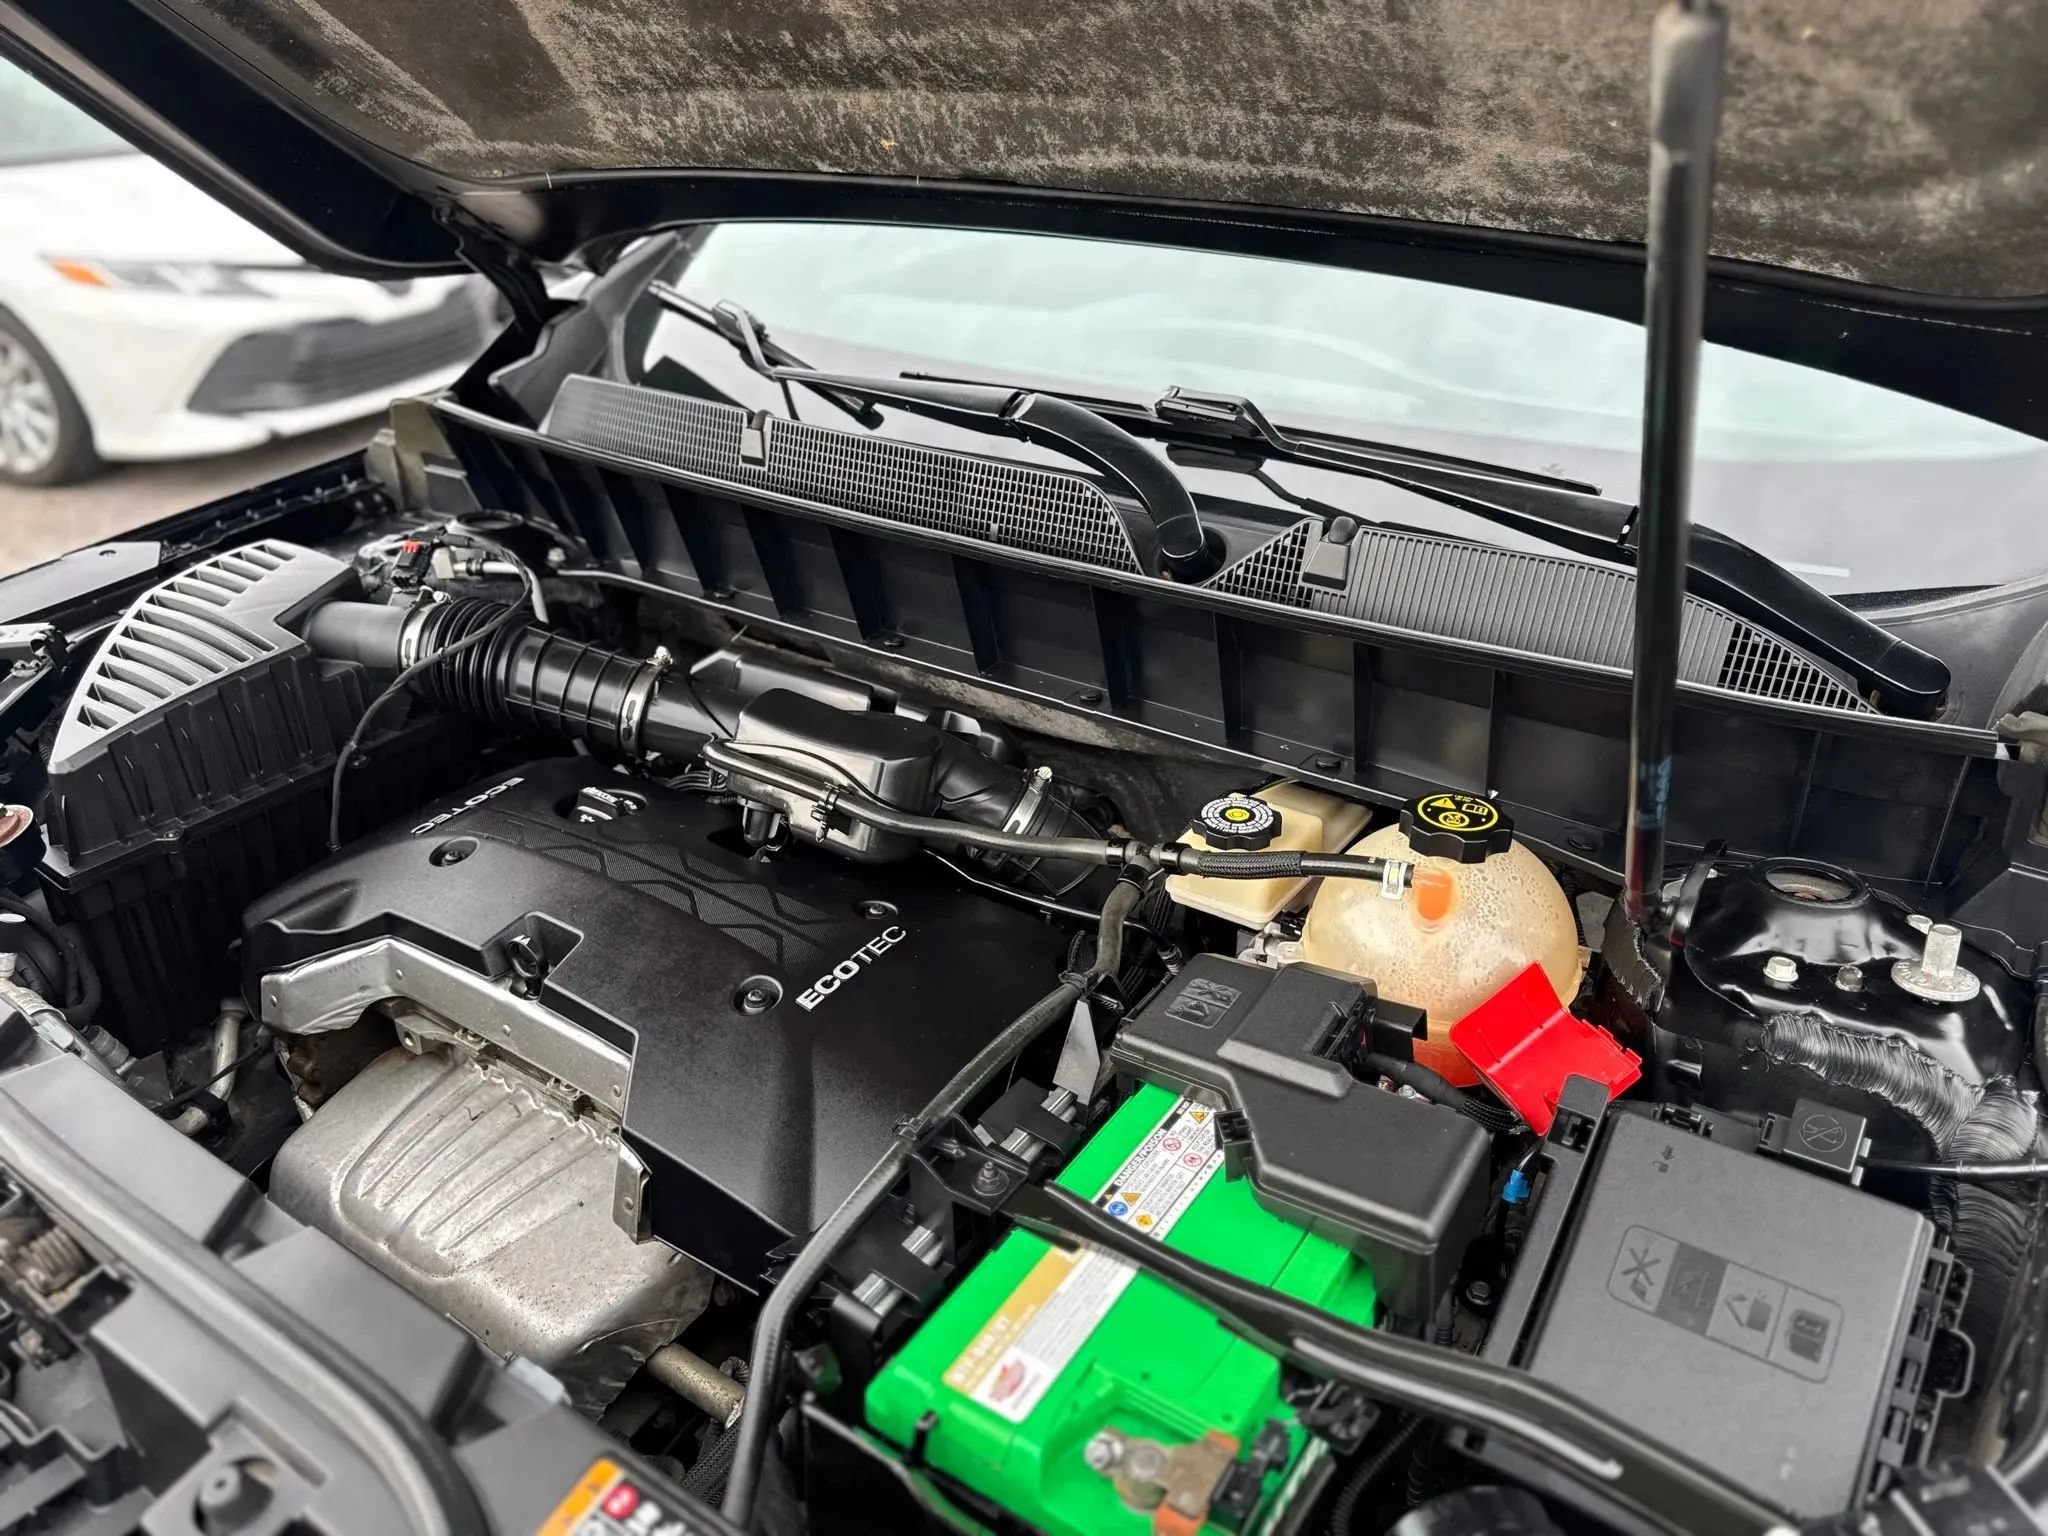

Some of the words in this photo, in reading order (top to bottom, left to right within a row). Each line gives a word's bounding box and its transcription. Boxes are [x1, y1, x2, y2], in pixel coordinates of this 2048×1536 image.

[410, 776, 525, 836] ECOTEC
[582, 786, 619, 803] dexos
[796, 926, 906, 1012] ECOTEC
[1114, 1128, 1168, 1187] DANGER/POISON
